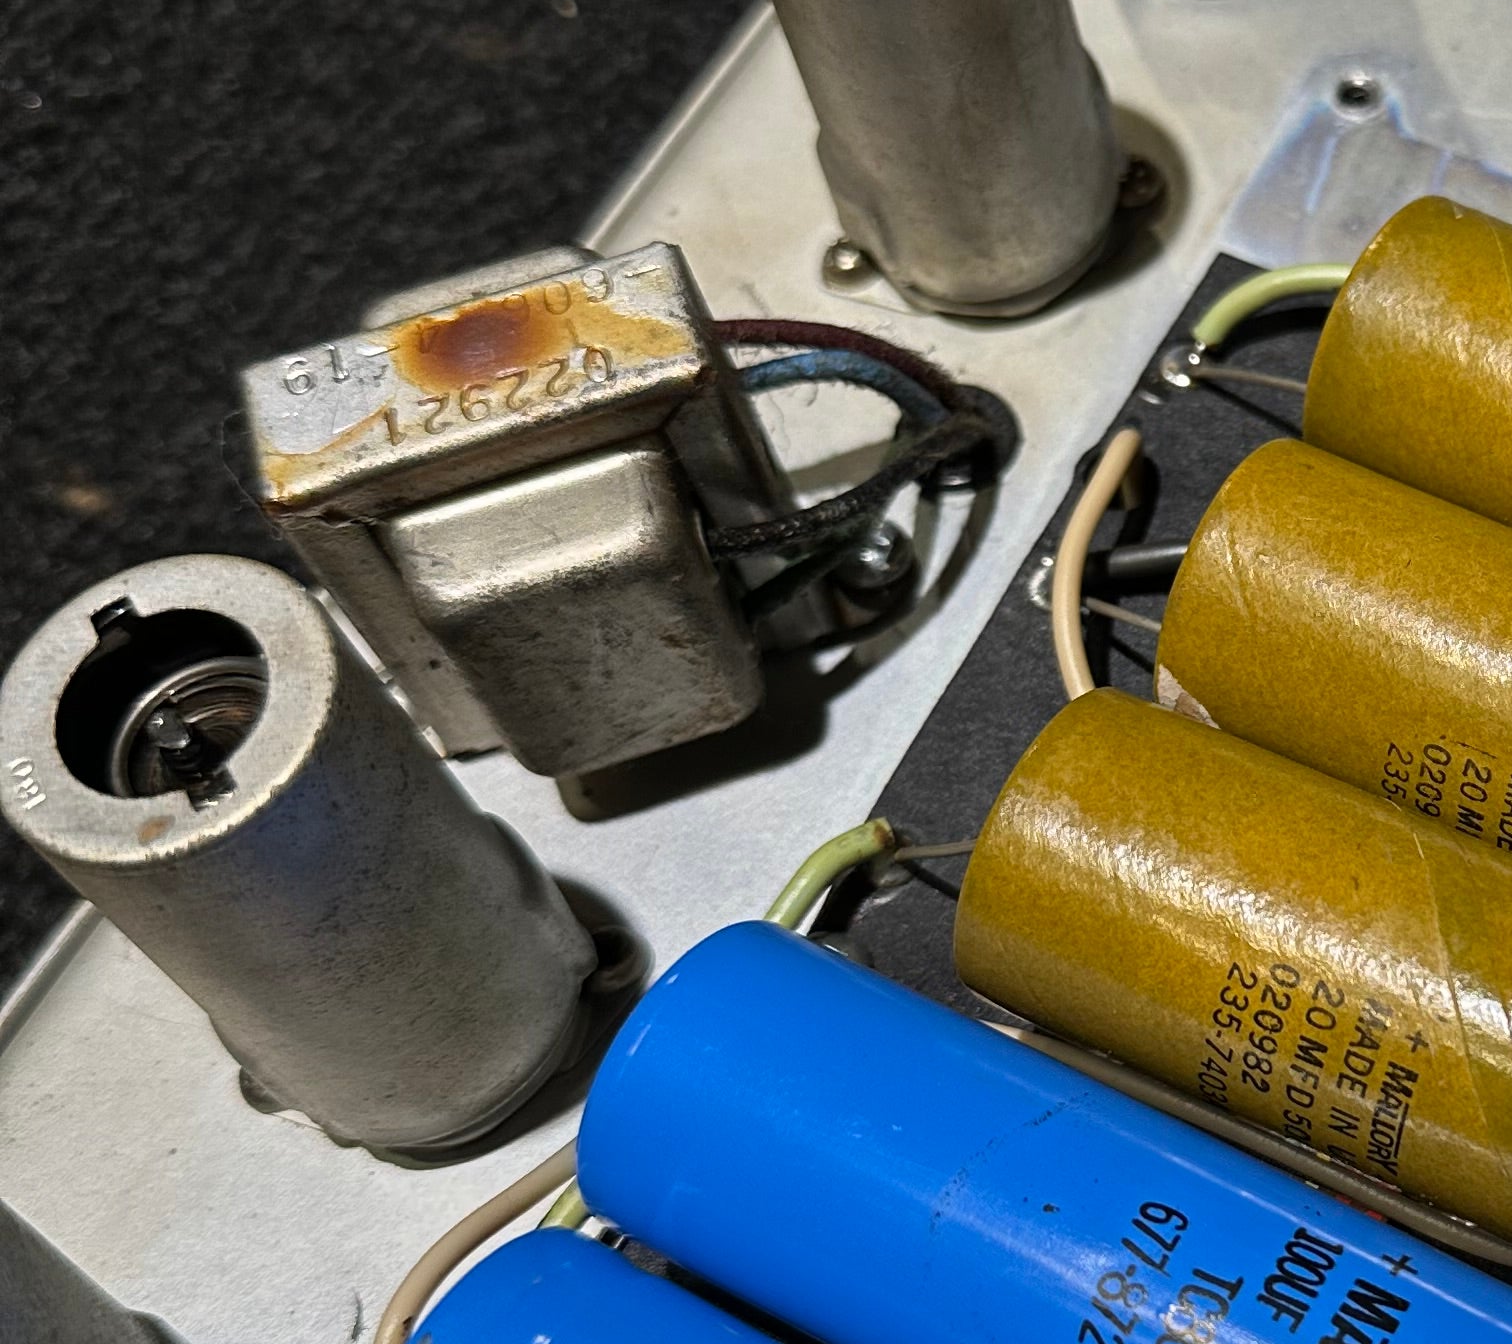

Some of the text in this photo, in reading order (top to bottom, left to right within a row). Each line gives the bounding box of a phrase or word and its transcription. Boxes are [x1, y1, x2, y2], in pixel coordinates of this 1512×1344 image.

[1241, 963, 1300, 1093] 020982
[1336, 998, 1393, 1098] MADE
[1328, 1107, 1361, 1140] IN
[1367, 1061, 1419, 1176] MALLORY
[1256, 1227, 1344, 1334] 100UF
